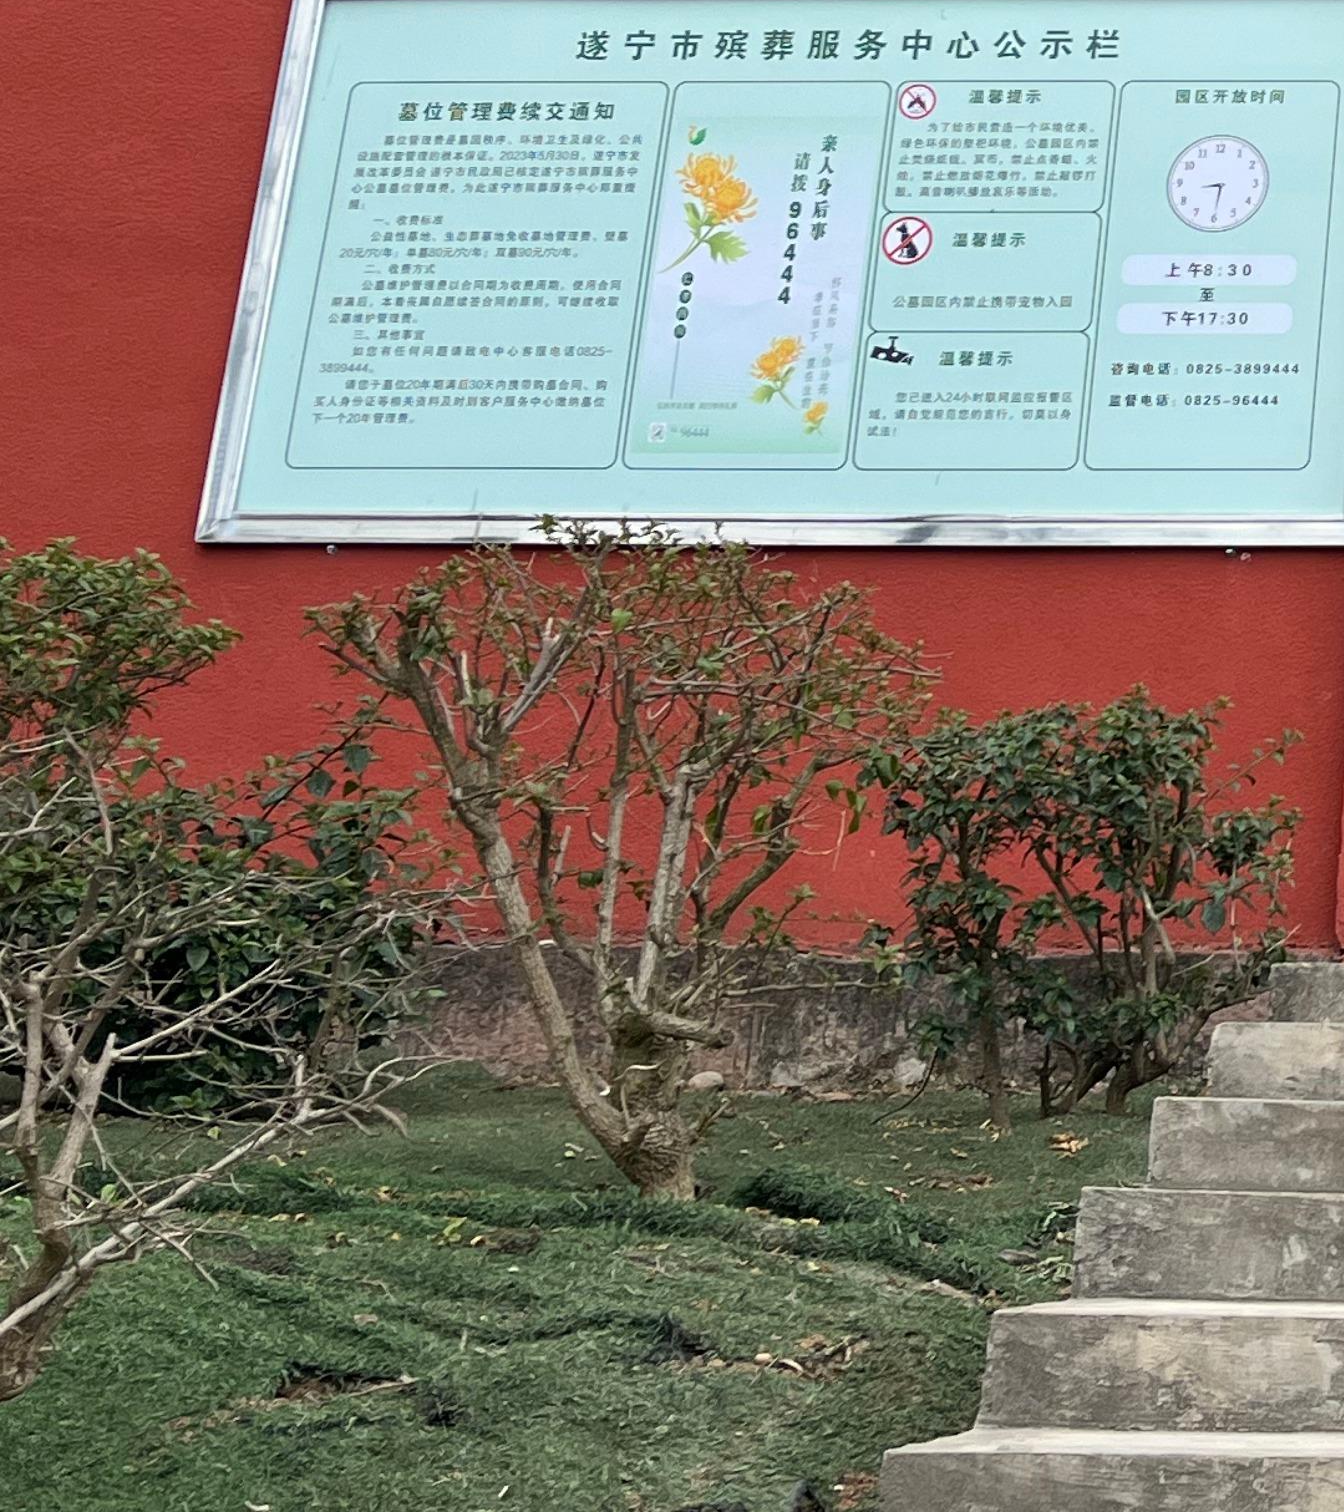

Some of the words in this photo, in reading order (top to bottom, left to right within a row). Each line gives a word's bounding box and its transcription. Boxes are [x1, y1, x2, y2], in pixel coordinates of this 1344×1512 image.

[574, 28, 1121, 61] 遂宁市殡葬服务中心公示栏
[967, 88, 1042, 105] 温馨提示
[1174, 88, 1286, 105] 园区开放时间
[397, 101, 616, 122] 墓位管理费续交通知
[811, 134, 838, 241] 亲人身后事
[951, 231, 1027, 249] 温馨提示
[891, 295, 1073, 309] 公墓园区内禁止携带宠物入园
[1198, 287, 1215, 303] 至
[1162, 310, 1250, 326] 下午17:30
[938, 350, 1014, 367] 温馨提示
